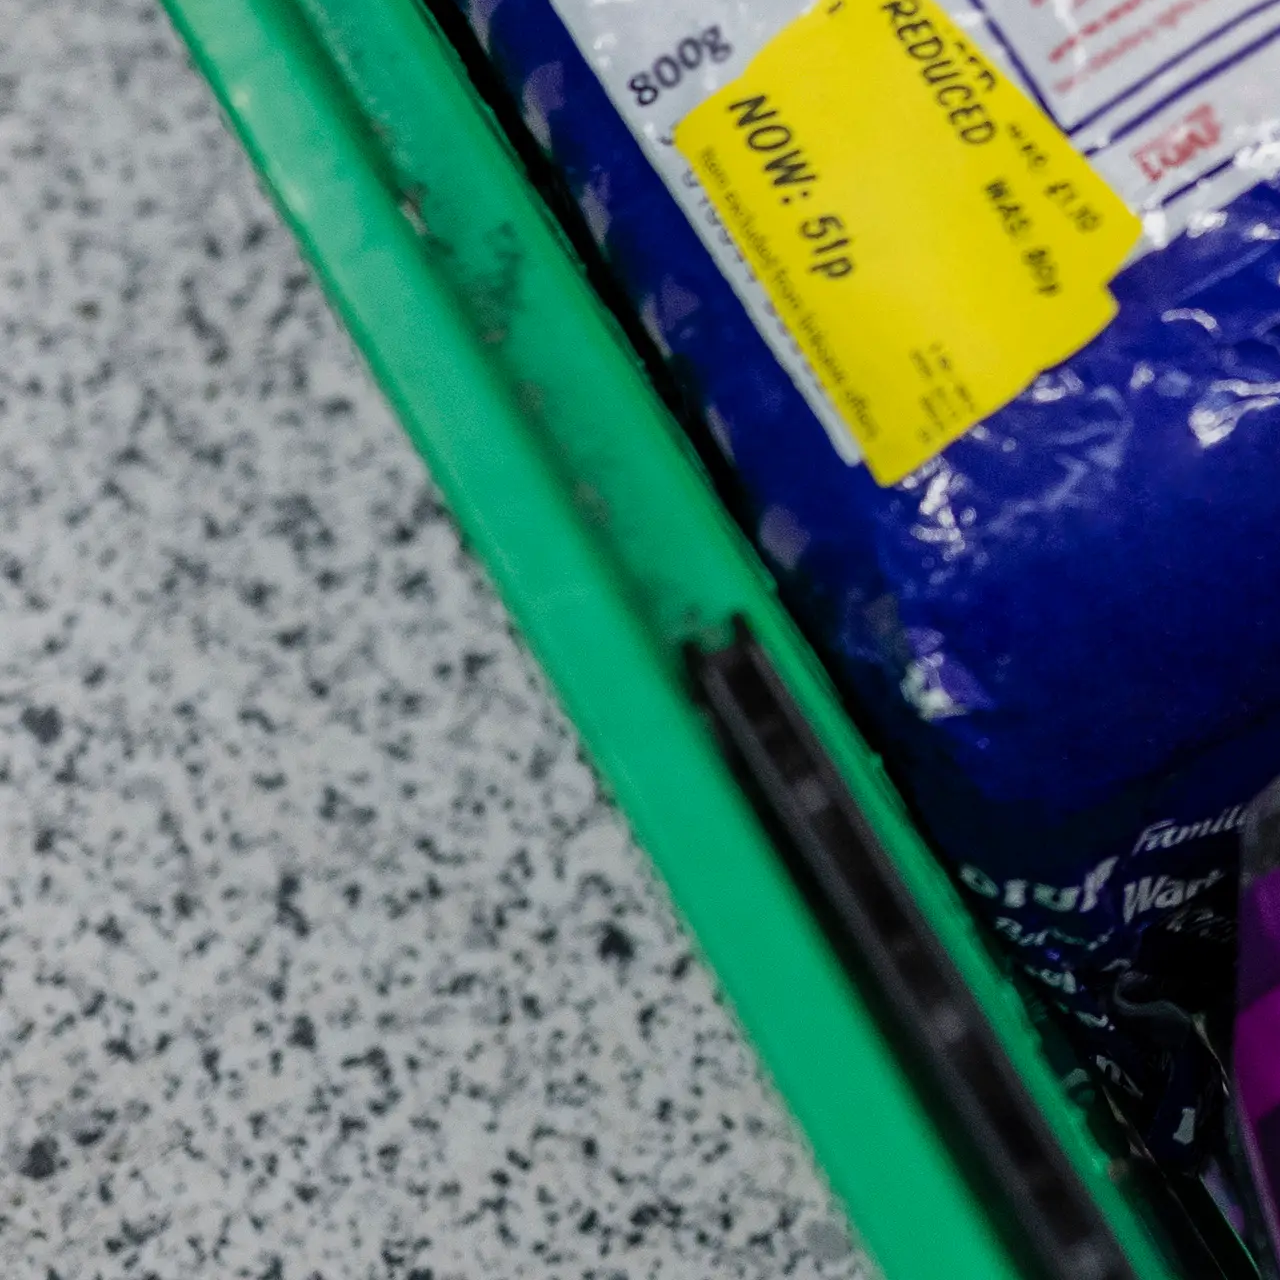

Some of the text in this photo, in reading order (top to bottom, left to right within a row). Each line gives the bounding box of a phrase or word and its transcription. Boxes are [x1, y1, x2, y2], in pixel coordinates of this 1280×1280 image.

[627, 25, 732, 108] 800g
[727, 94, 856, 280] NOW: 51p
